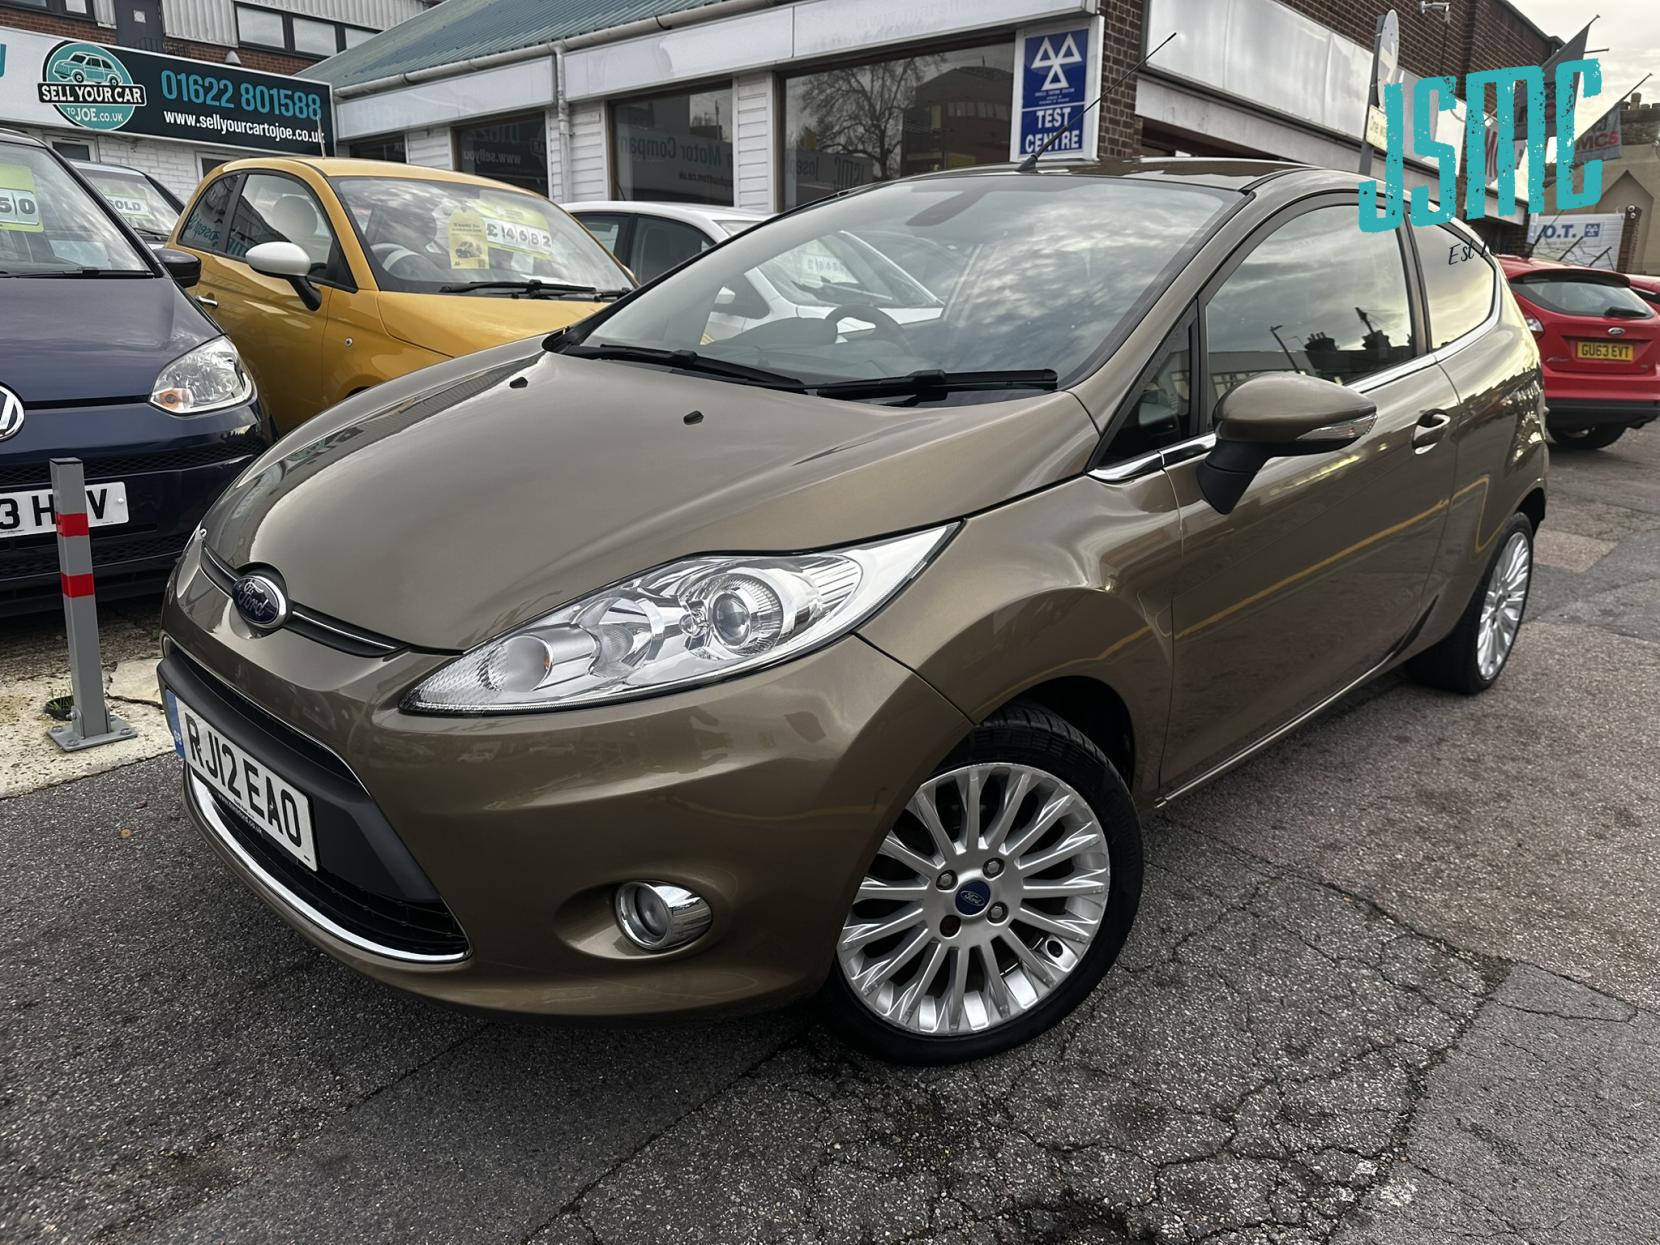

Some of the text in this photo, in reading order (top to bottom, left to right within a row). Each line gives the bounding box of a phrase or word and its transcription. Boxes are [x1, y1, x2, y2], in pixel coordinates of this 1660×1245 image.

[41, 85, 142, 103] SELL YOUR CAR
[160, 69, 322, 120] 01622 801588
[66, 107, 76, 115] TO
[1036, 107, 1071, 128] TEST
[163, 111, 326, 143] www.sellyourcartojoe.co.uk
[1581, 343, 1609, 357] GU63
[31, 488, 108, 527] HV
